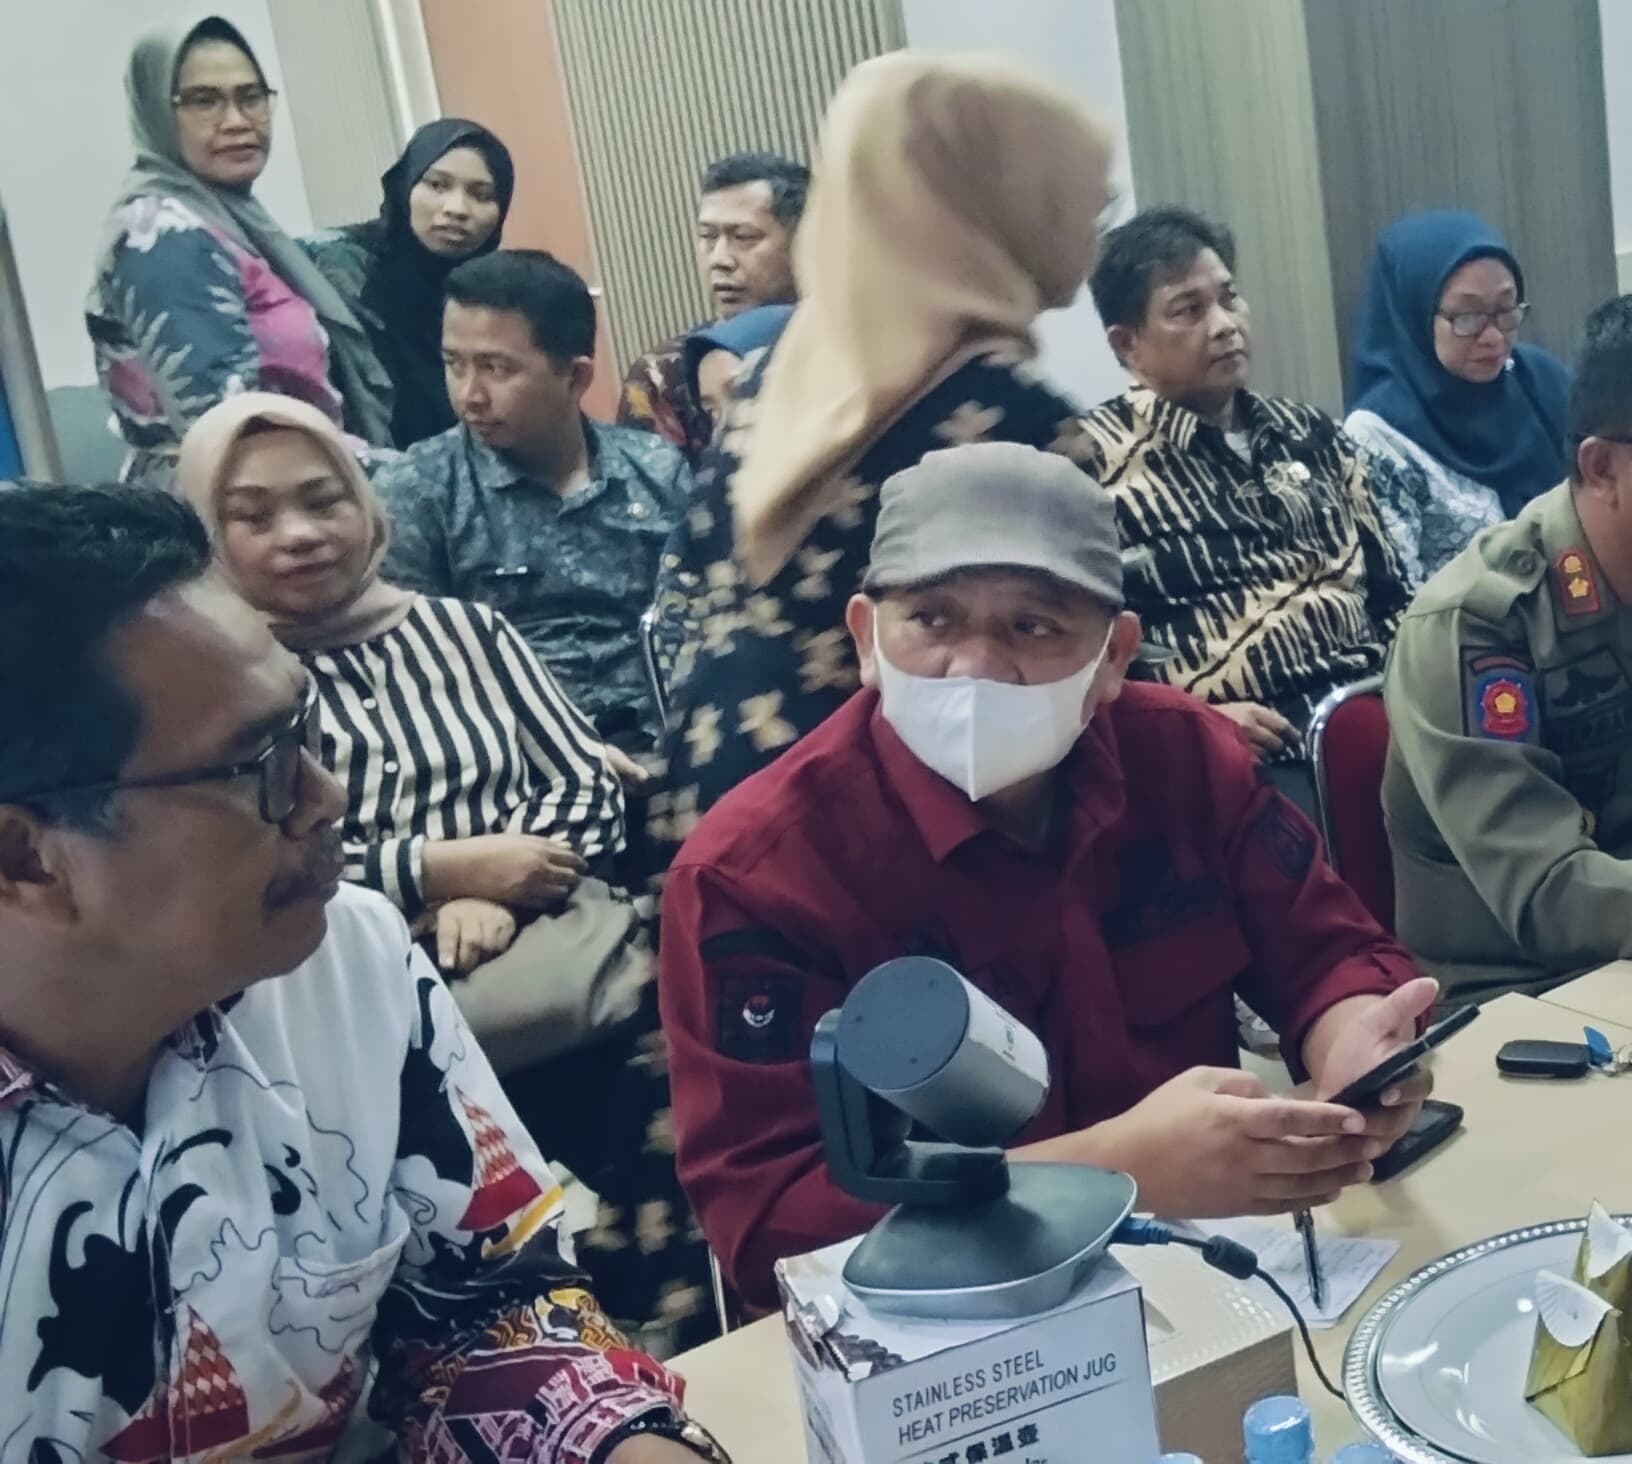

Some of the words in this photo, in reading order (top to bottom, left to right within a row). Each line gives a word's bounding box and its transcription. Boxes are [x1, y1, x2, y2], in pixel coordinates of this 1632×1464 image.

[893, 1369, 986, 1417] STAINLESS
[992, 1349, 1044, 1383] STEEL
[898, 1411, 945, 1445] HEAT
[949, 1366, 1078, 1427] PRESERVATION
[1083, 1353, 1116, 1381] JUG
